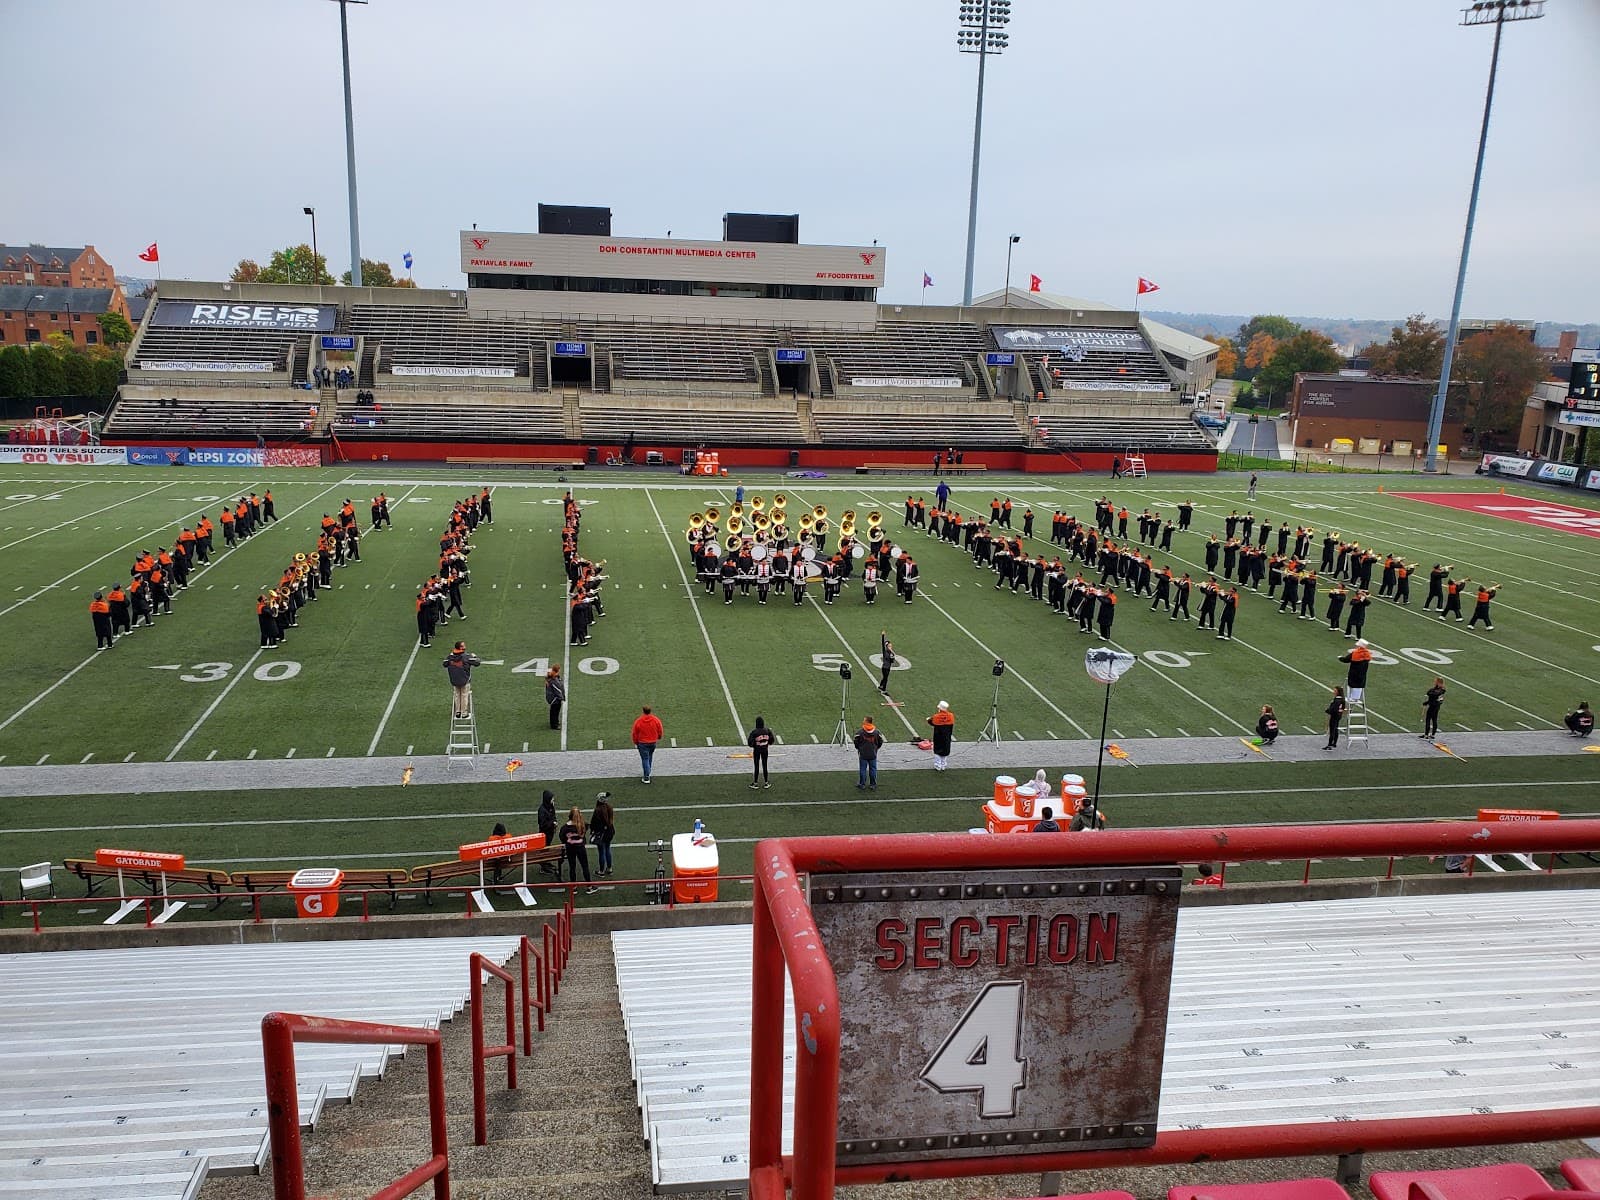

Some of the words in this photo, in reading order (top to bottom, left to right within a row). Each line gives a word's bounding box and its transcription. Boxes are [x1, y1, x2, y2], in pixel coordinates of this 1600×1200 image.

[619, 247, 673, 255] CONSTANTINI
[675, 249, 723, 257] MULTIMEDIA
[725, 250, 756, 259] CENTER
[192, 304, 275, 321] RISE
[276, 314, 319, 323] PIES
[190, 319, 277, 327] HANDCRAFTED
[1047, 330, 1142, 340] SOUTHWOODS
[1071, 338, 1126, 346] HEALTH
[22, 453, 48, 463] GO
[54, 453, 95, 464] YSU!
[189, 452, 223, 462] PEPSI
[227, 453, 265, 463] ZONE
[704, 464, 713, 473] G
[811, 653, 912, 672] 50
[1142, 650, 1191, 668] 0
[180, 661, 302, 683] 30
[511, 656, 620, 677] 40
[1498, 814, 1541, 822] GATORADE
[481, 841, 528, 855] GATORADE
[115, 857, 162, 868] GATORADE
[303, 894, 323, 913] G
[874, 911, 1120, 970] SECTION
[919, 979, 1028, 1119] 4
